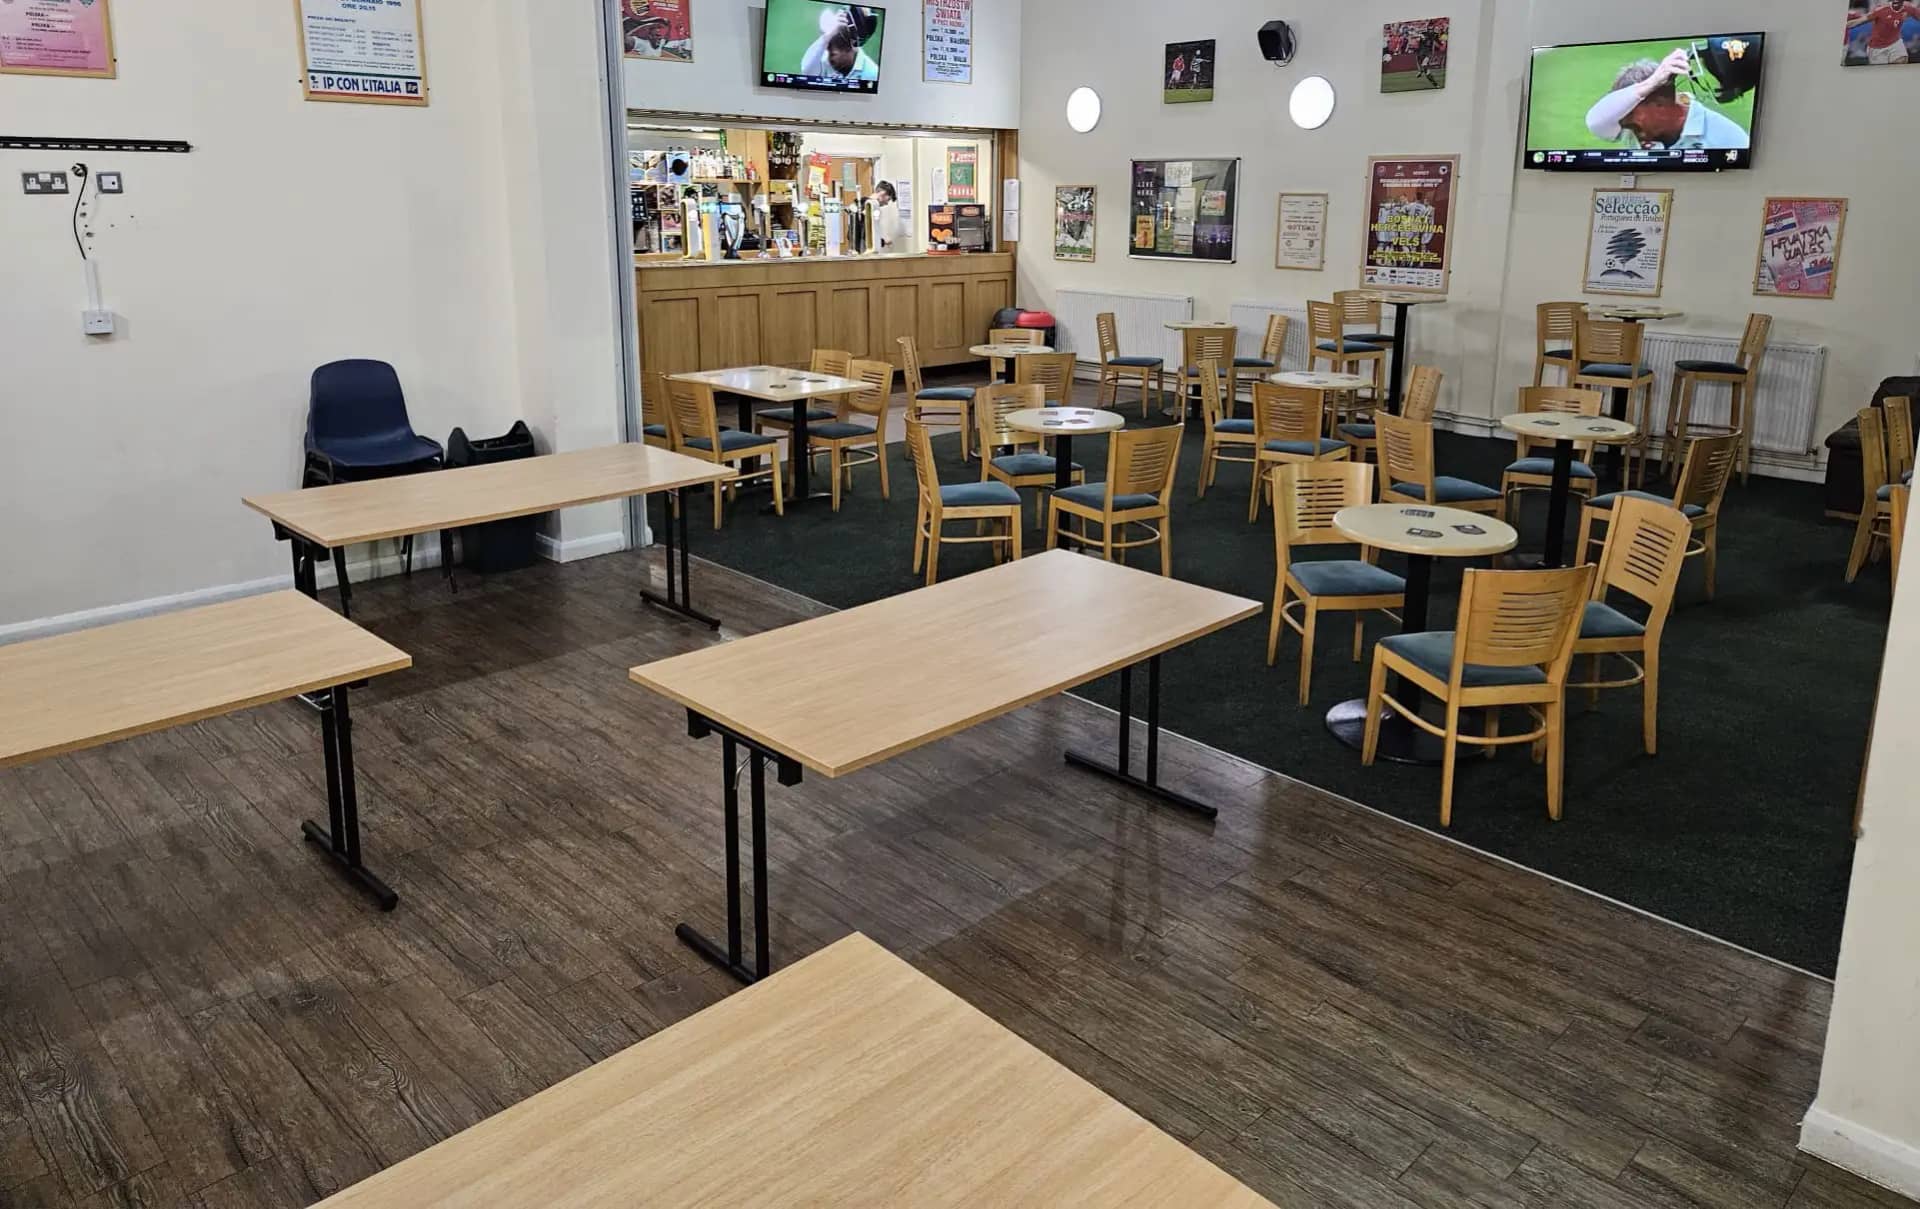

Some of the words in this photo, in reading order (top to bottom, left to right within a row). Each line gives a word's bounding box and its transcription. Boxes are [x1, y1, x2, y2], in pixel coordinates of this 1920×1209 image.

[323, 76, 335, 89] IP
[337, 77, 359, 91] CON
[361, 78, 402, 93] L'ITALIA
[1595, 198, 1660, 217] Selecção
[1392, 237, 1420, 246] VELS
[1771, 225, 1832, 257] HRVATSKA
